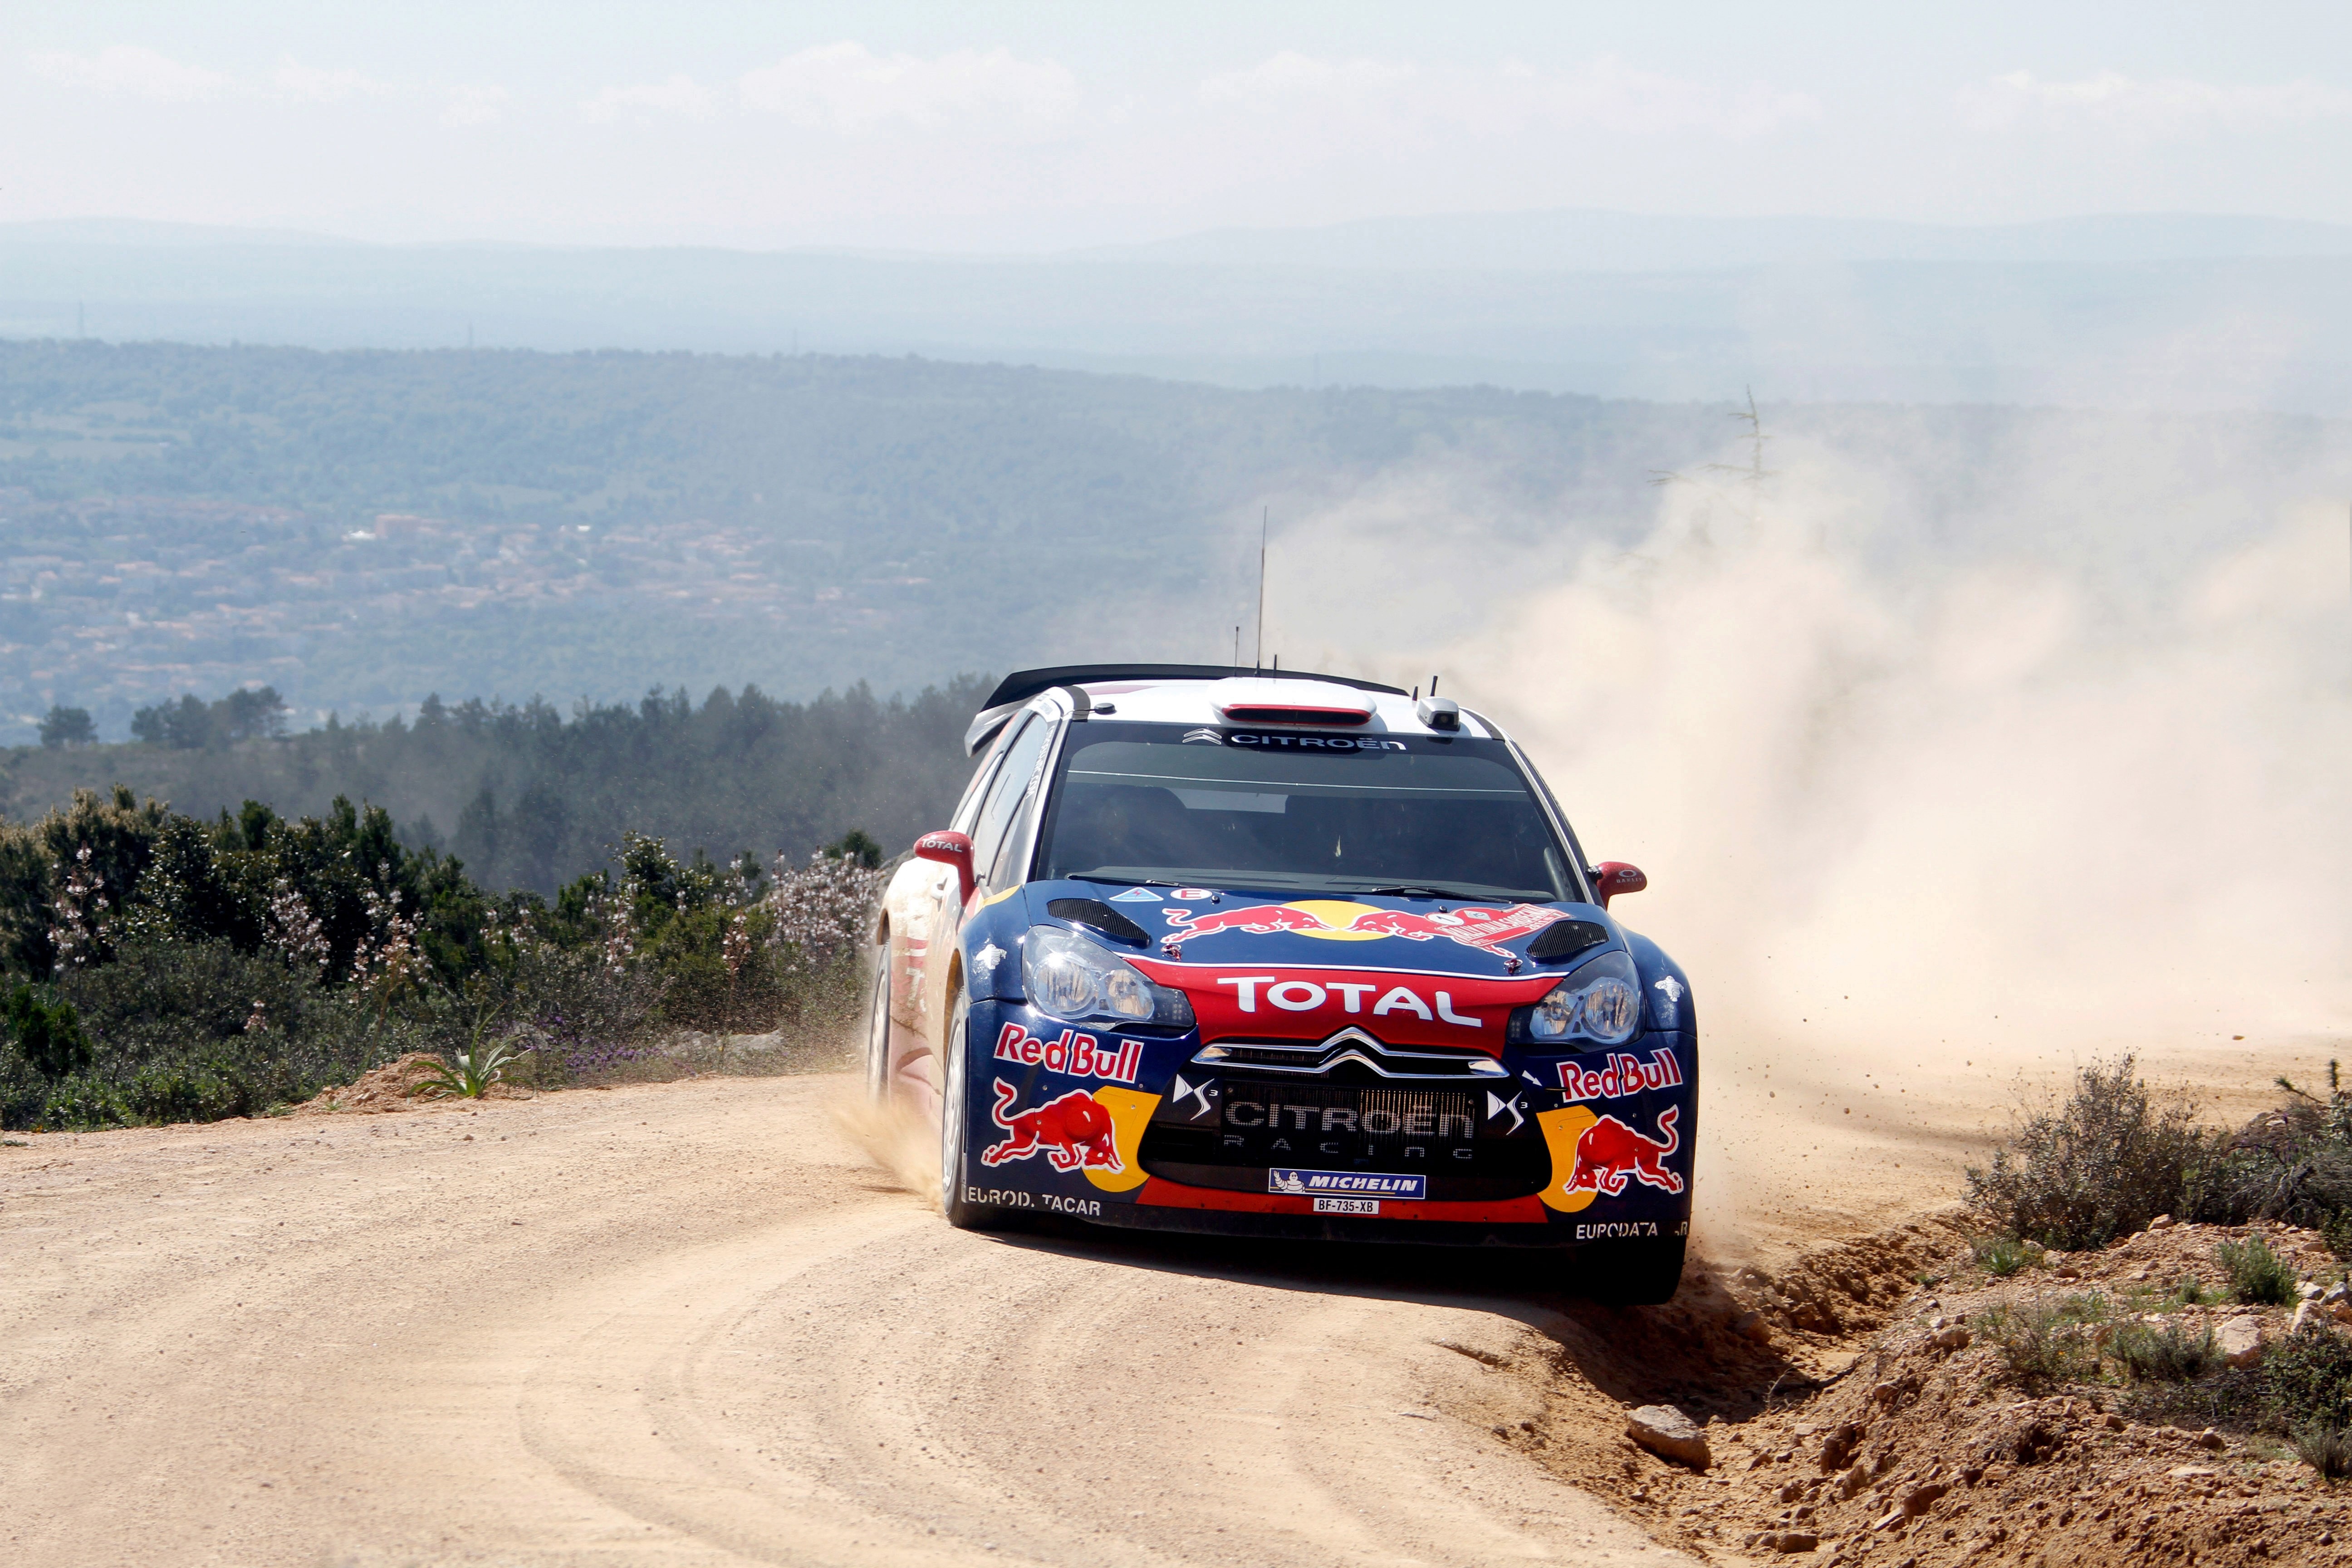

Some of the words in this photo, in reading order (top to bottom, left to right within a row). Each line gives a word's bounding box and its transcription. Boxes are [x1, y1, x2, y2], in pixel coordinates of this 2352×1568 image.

[921, 838, 962, 853] TOTAL
[1181, 890, 1201, 898] E
[1441, 925, 1487, 939] RALLY
[1499, 906, 1550, 926] SARDEGNA
[1524, 920, 1548, 929] 2011
[1217, 975, 1482, 1028] TOTAL
[1308, 1175, 1418, 1192] MICHELIN
[1318, 1199, 1374, 1213] BF-735-XB
